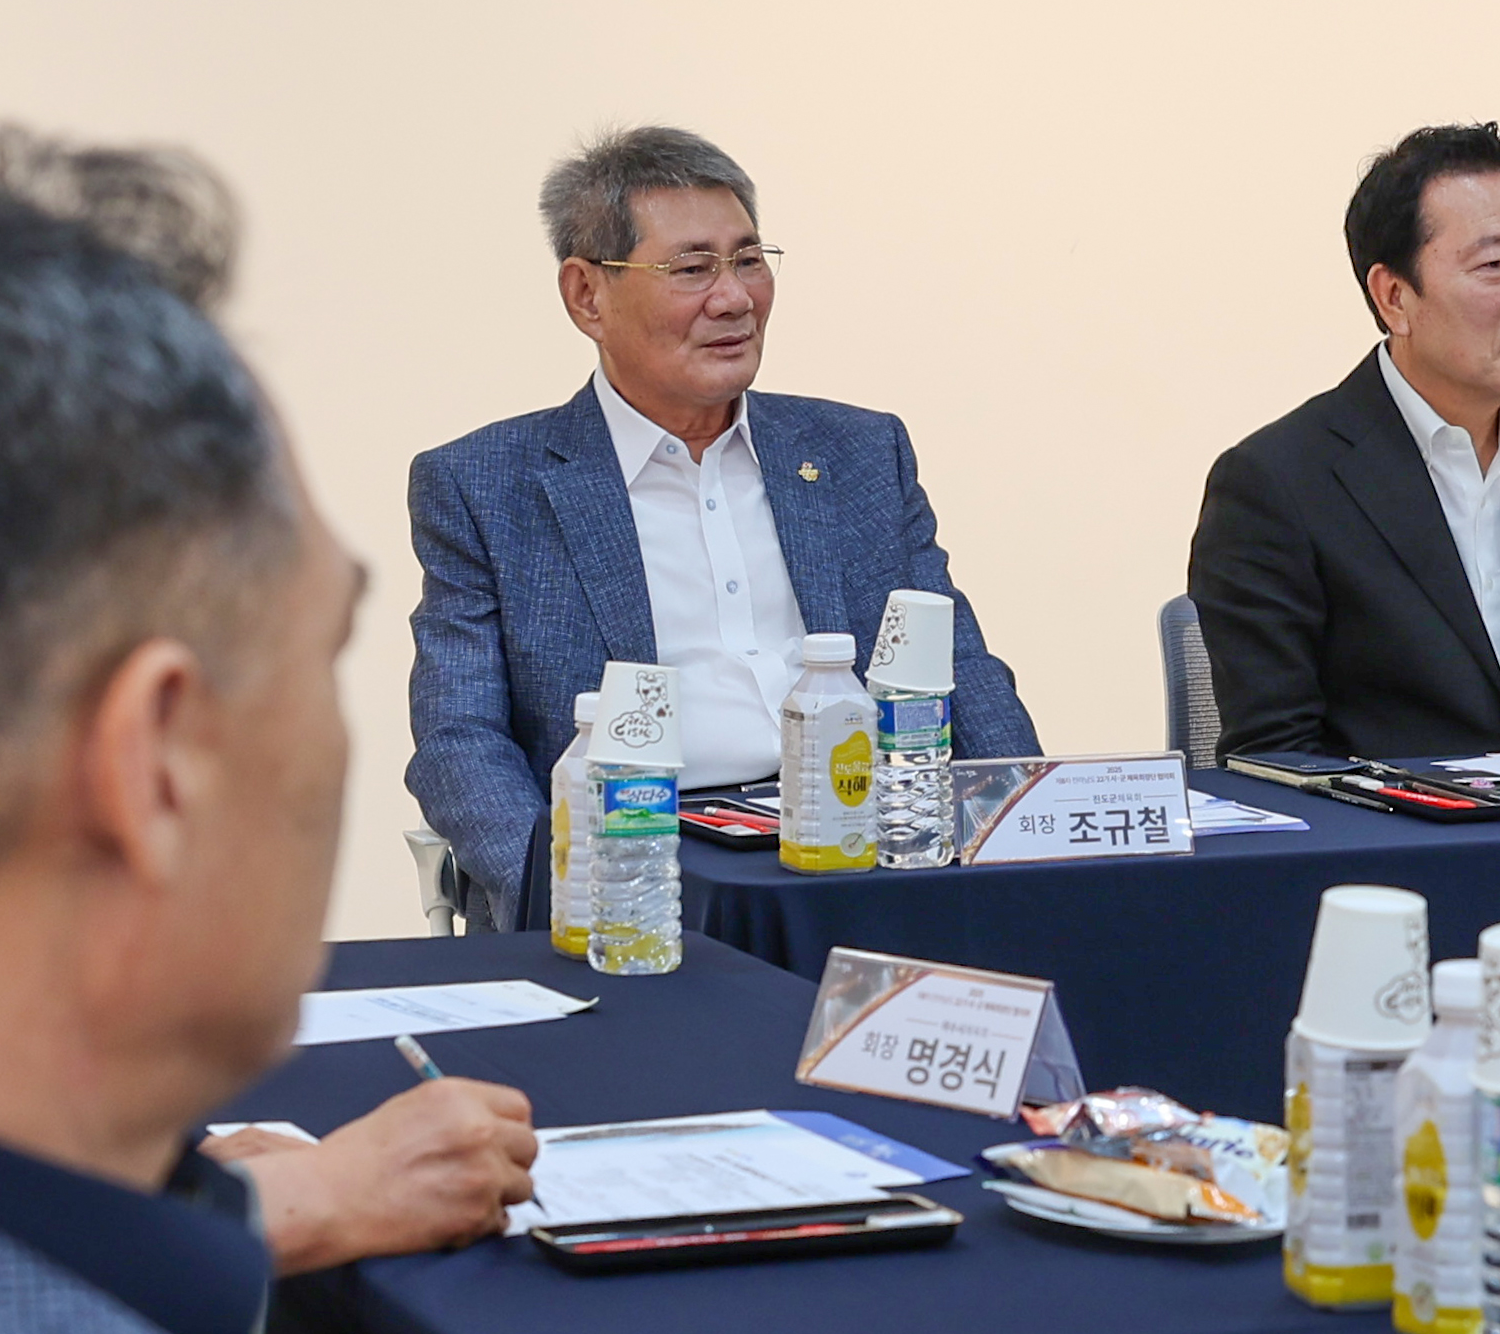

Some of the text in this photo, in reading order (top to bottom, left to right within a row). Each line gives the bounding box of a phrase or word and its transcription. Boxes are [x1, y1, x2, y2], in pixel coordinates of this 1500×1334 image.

[837, 775, 867, 797] 식혜
[1018, 805, 1171, 846] 회장 조규철
[862, 1030, 1007, 1100] 회장 명경식
